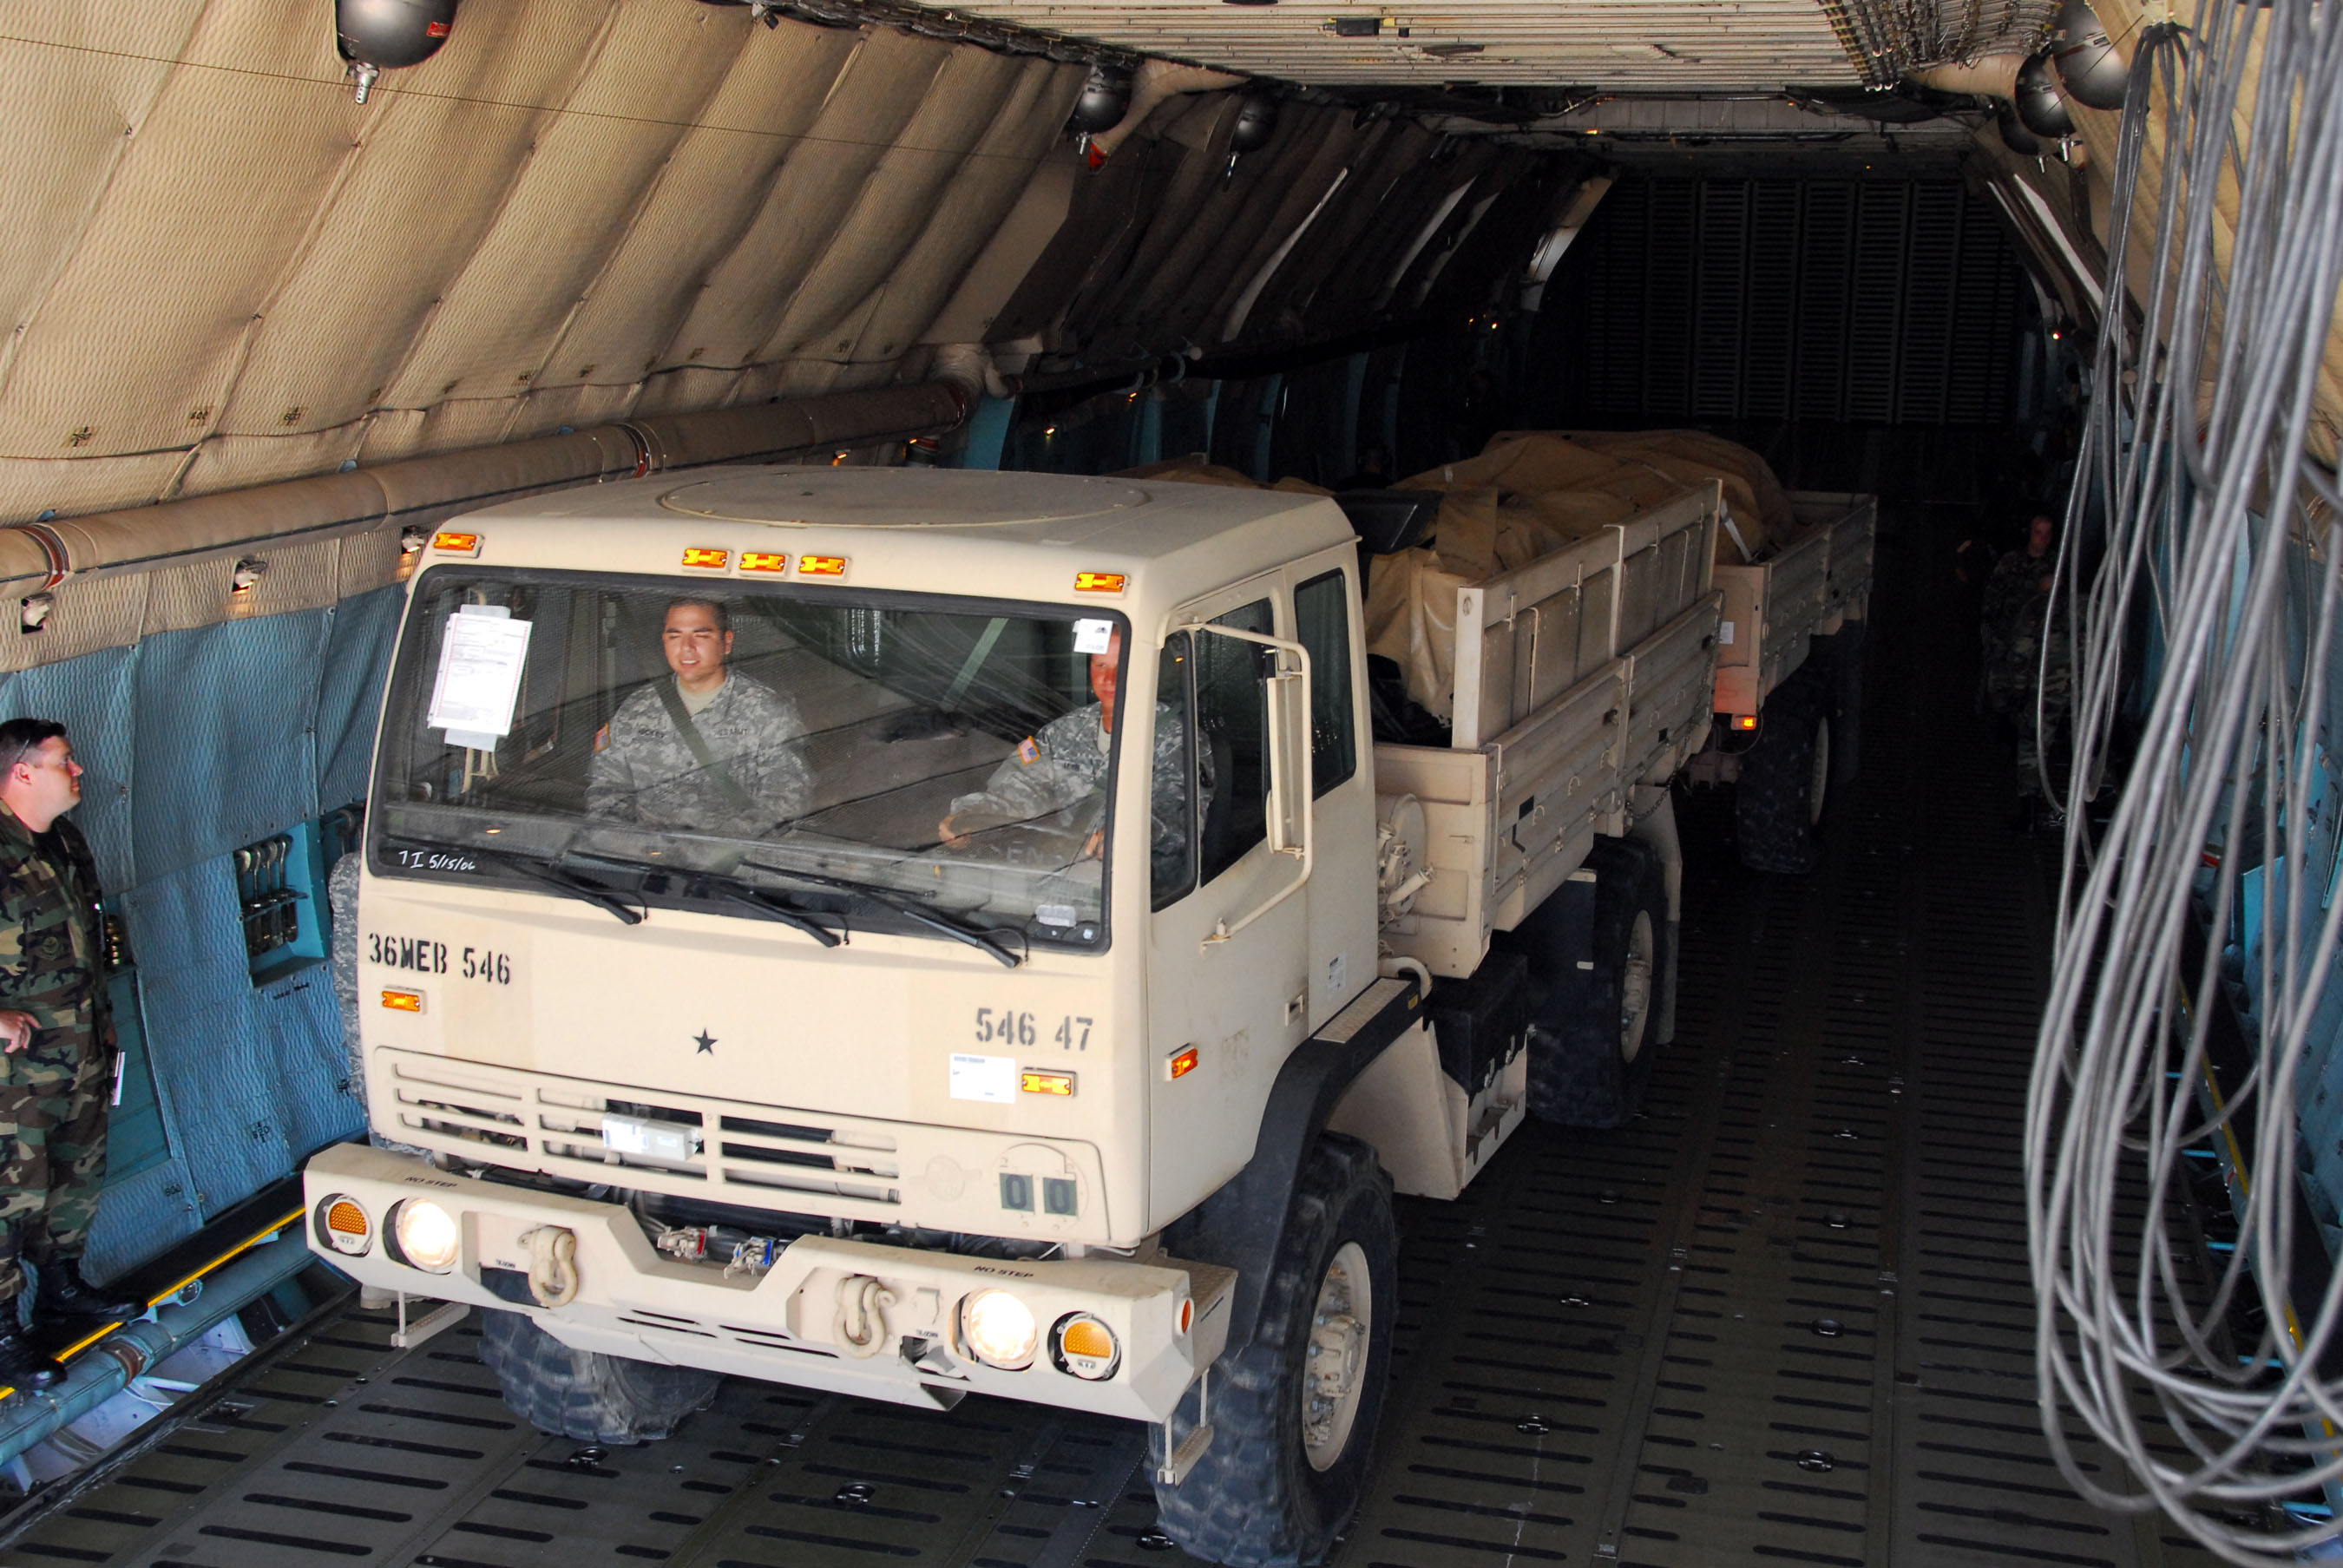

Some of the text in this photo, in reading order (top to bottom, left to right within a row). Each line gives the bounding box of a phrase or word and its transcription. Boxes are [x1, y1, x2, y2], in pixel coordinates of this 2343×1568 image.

[462, 946, 510, 985] 546
[975, 1007, 1093, 1052] 546 47
[997, 1269, 1034, 1278] STEP
